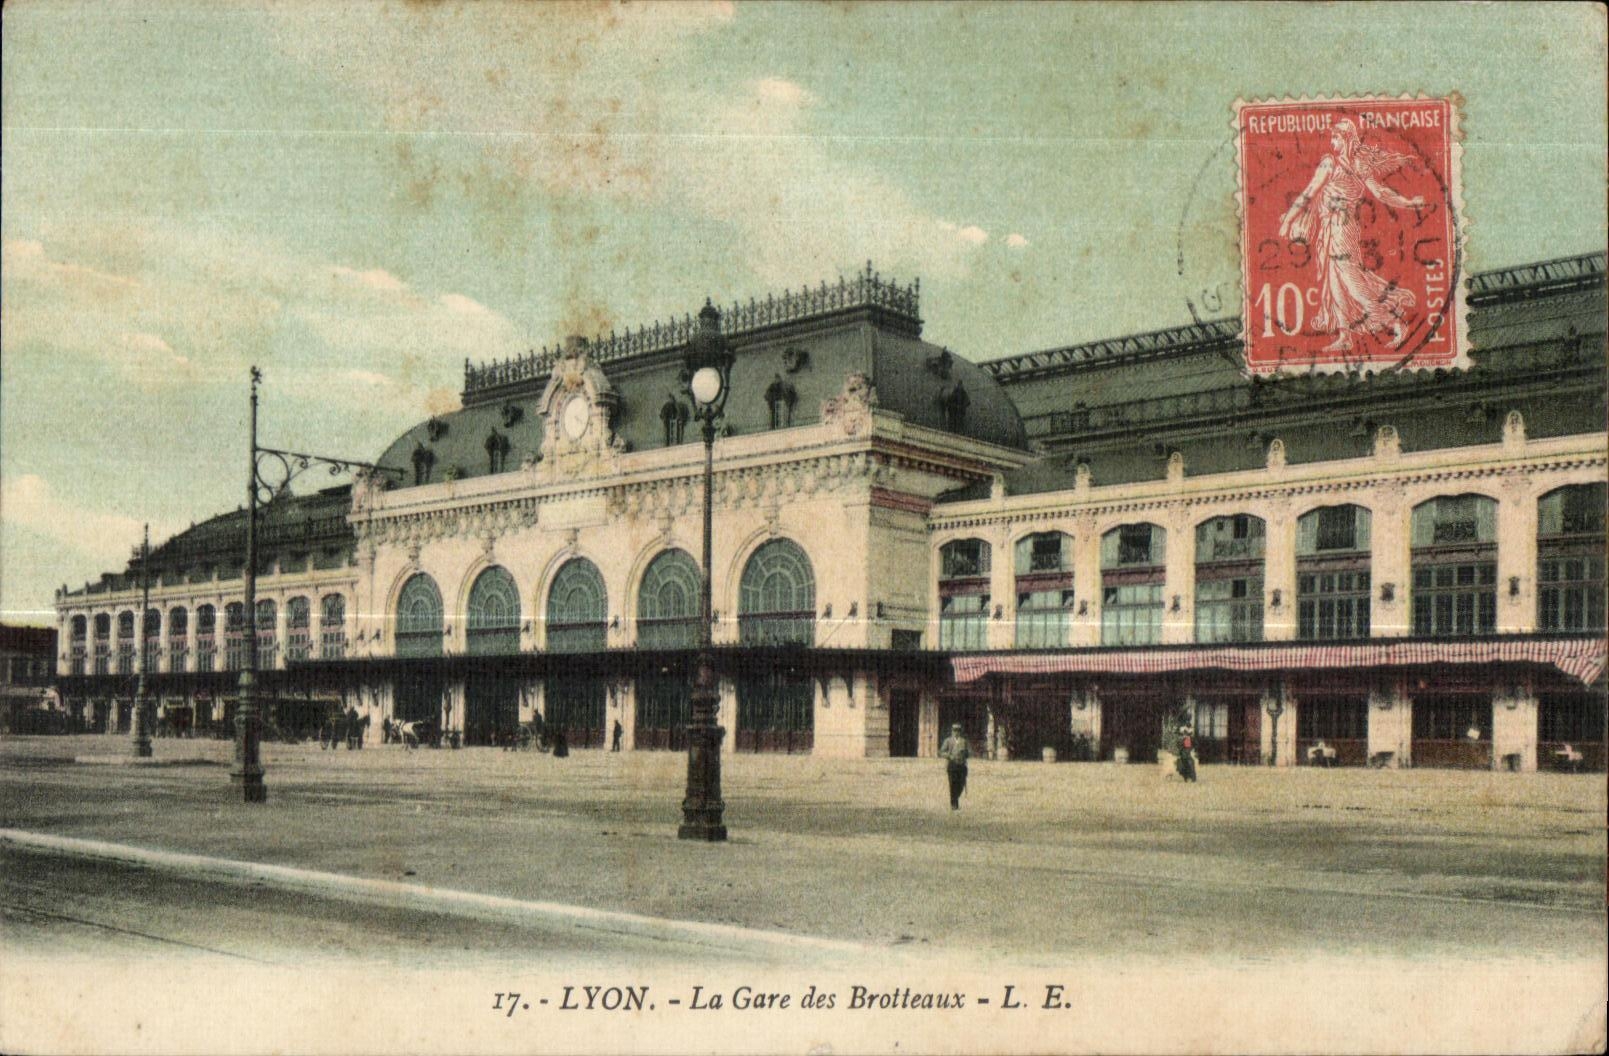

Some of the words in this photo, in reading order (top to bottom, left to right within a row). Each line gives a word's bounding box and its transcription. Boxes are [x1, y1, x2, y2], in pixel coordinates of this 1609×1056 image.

[1249, 114, 1332, 133] REPUBLIQUE
[1359, 110, 1440, 129] FRANÇAISE
[1426, 258, 1446, 343] POSTES
